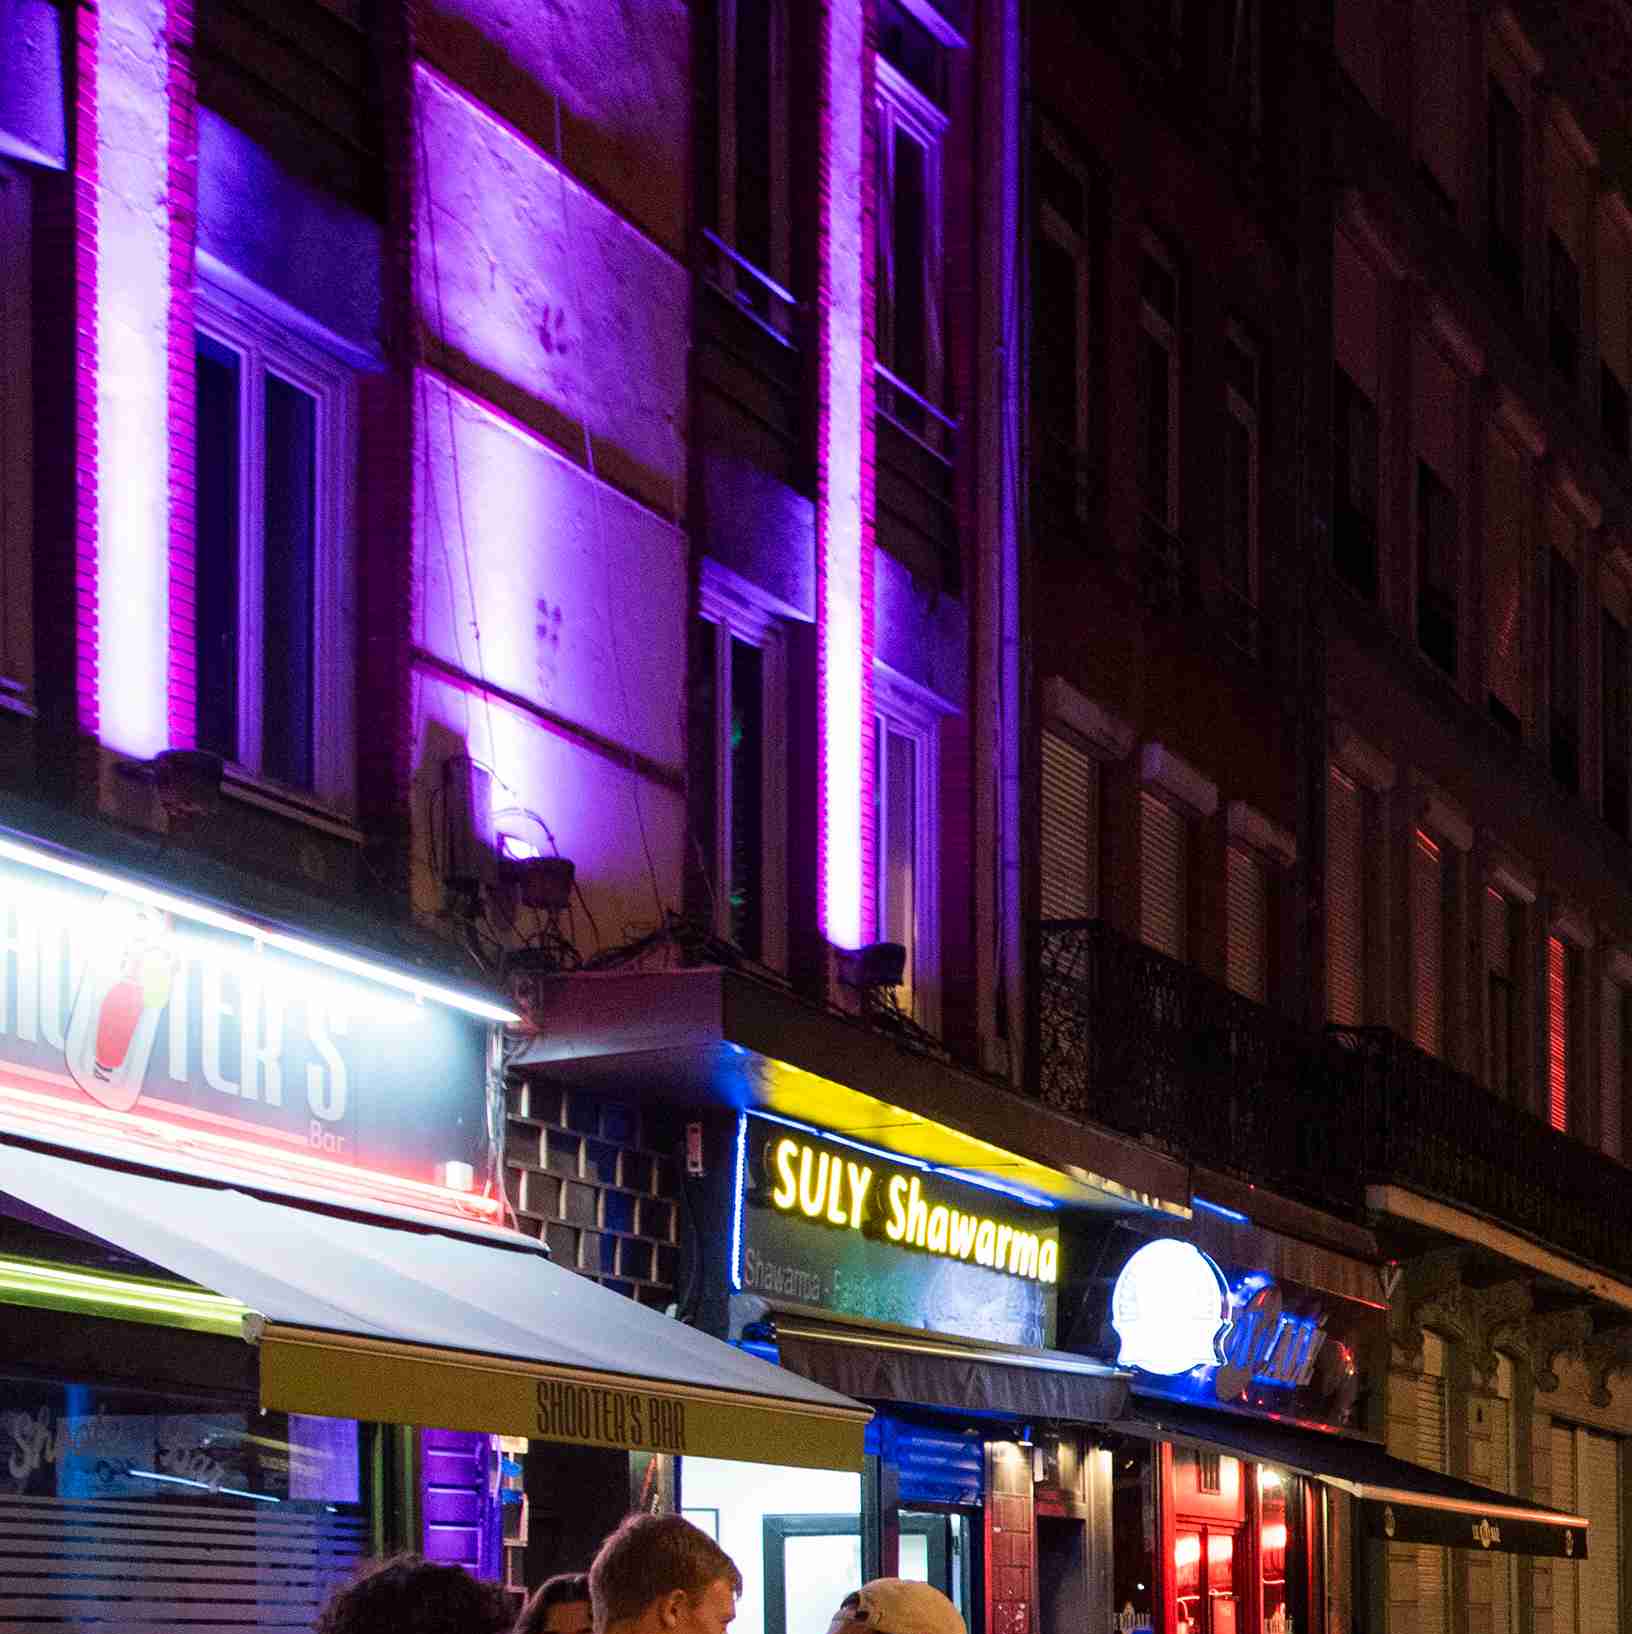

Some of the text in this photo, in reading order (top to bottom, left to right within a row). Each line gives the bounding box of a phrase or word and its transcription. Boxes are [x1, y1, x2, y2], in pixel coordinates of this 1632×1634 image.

[309, 1121, 345, 1151] Bar
[775, 1139, 1058, 1283] SULY Shawarma
[536, 1381, 687, 1449] SHOOTER'S BAR
